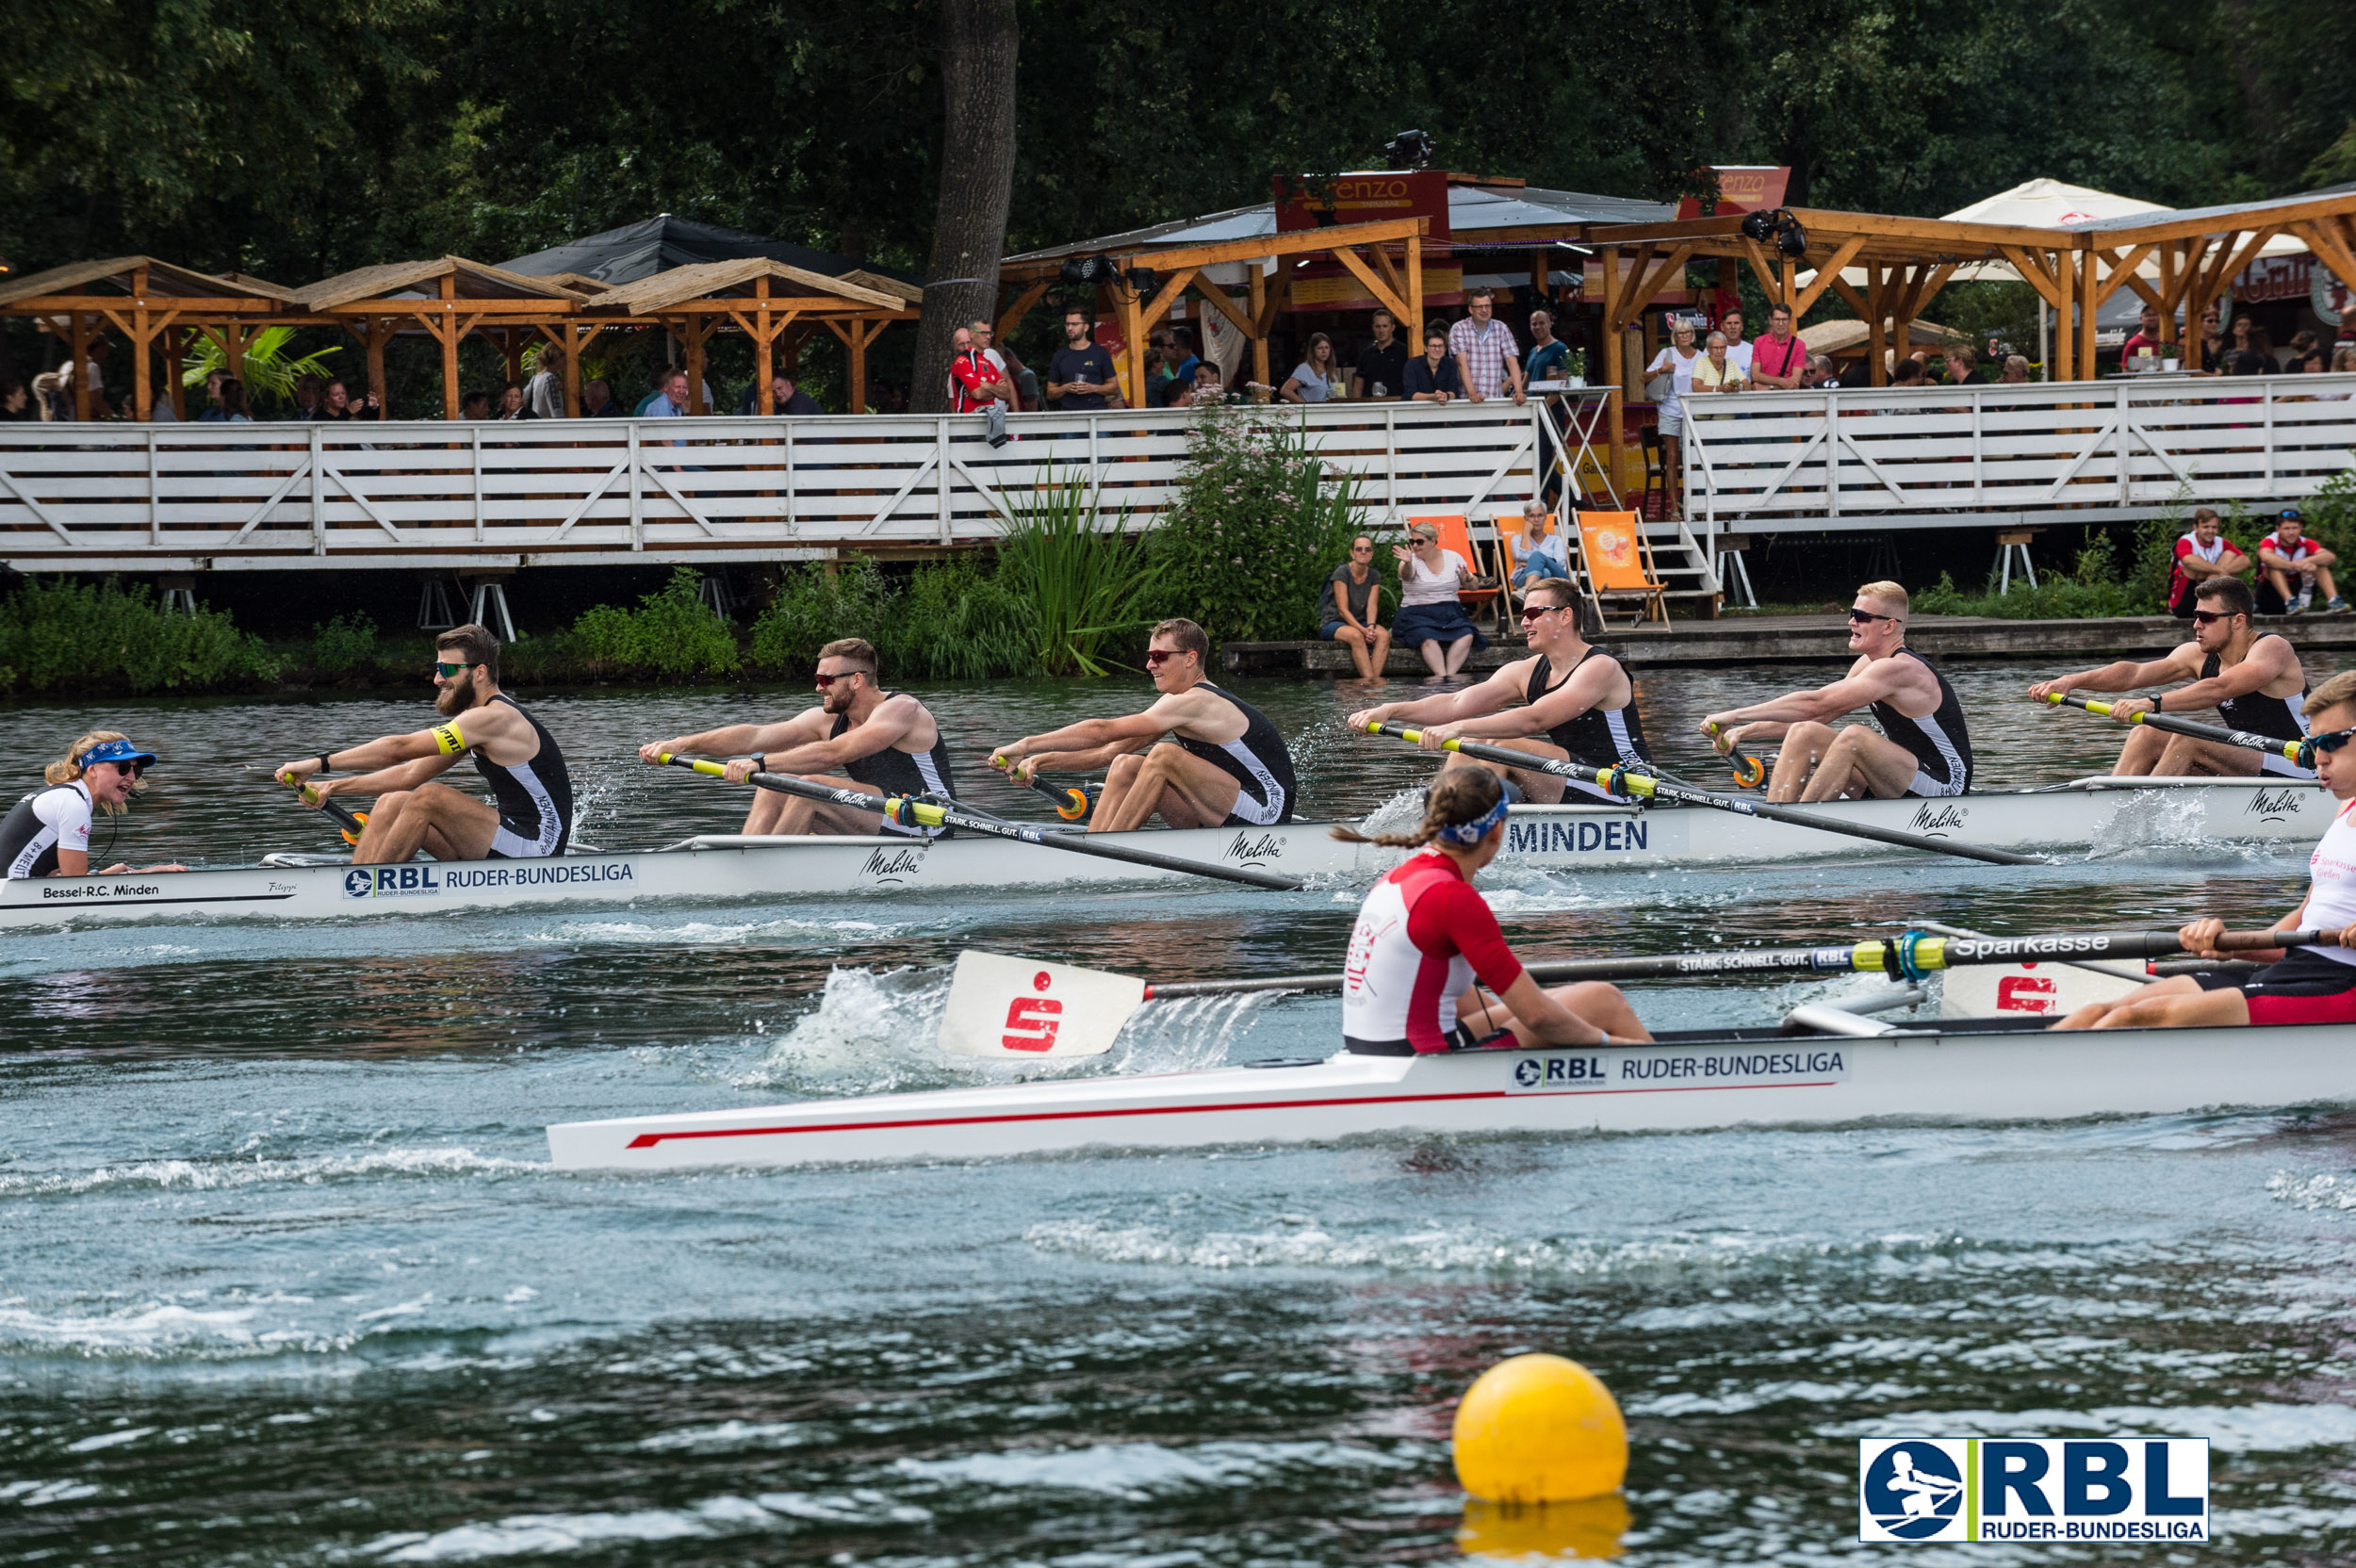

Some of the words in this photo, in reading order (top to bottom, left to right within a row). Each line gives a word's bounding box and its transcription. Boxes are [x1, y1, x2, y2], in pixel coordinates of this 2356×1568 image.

[1656, 787, 1679, 798] STARK.
[1680, 792, 1713, 805] SCHNELL.
[1713, 798, 1730, 808] GUT.
[1734, 801, 1753, 812] RBL
[944, 815, 968, 826] STARK.
[969, 820, 1001, 833] SCHNELL.
[1001, 827, 1019, 838] GUT.
[1022, 829, 1041, 841] RBL
[1508, 821, 1647, 853] MINDEN
[377, 867, 439, 890] RBL
[446, 863, 633, 888] RUDER-BUNDESLIGA
[43, 886, 110, 899] Bessel-R.C.
[114, 884, 159, 896] Minden
[1955, 936, 2110, 959] Sparkasse
[1681, 957, 1722, 972] STARK.
[1723, 955, 1780, 969] SCHNELL.
[1780, 953, 1809, 966] GUT.
[1817, 950, 1849, 962] RBL
[1546, 1057, 1606, 1080] RBL
[1622, 1053, 1843, 1079] RUDER-BUNDESLIGA
